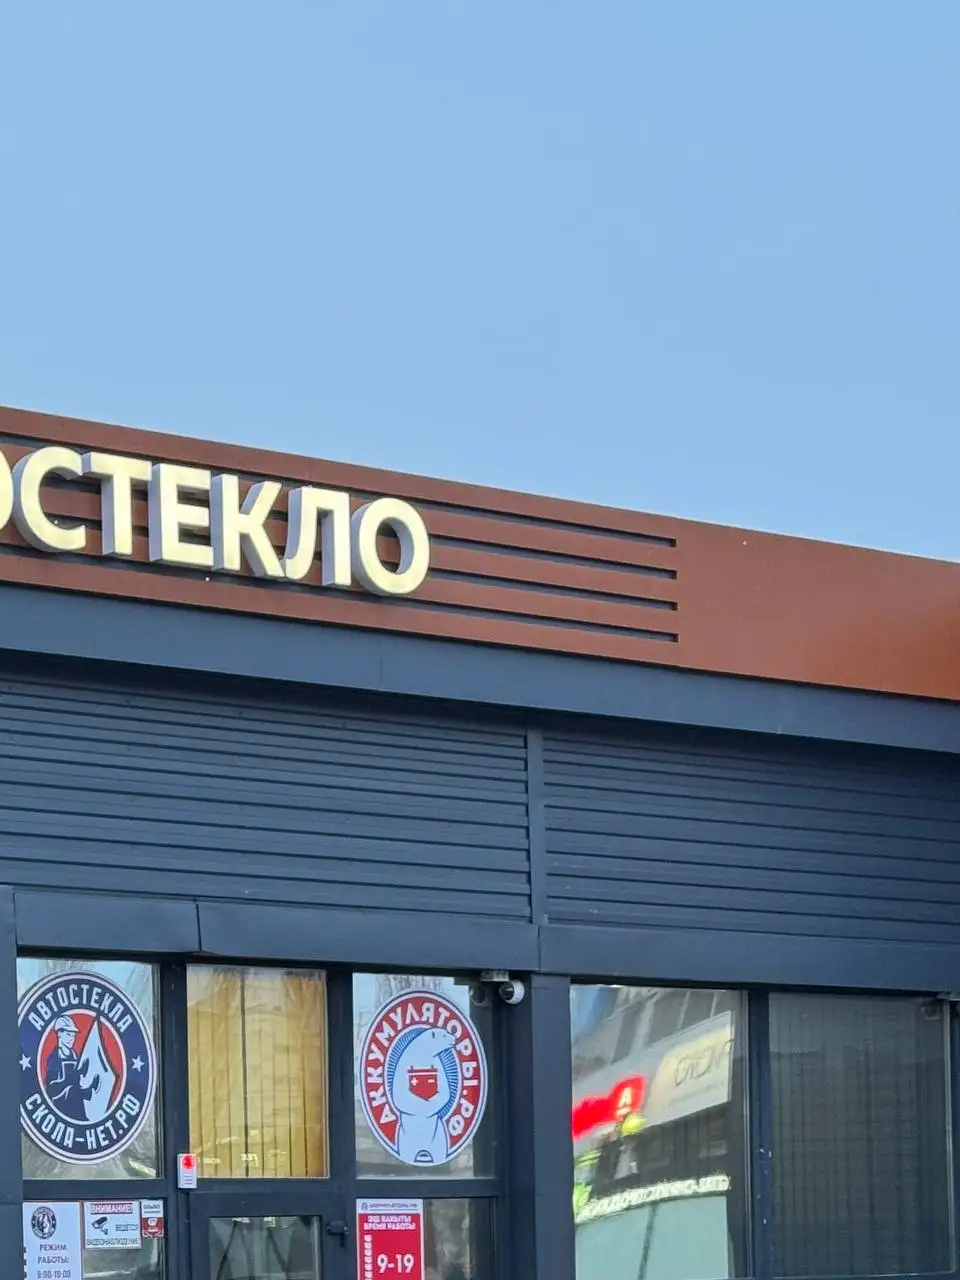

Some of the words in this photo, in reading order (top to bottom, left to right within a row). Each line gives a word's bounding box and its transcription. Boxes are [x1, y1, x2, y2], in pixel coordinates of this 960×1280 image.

[28, 984, 134, 1033] АВТОСТЕКЛА
[367, 1002, 479, 1137] АККУМУЛЯТОРЫ.РФ
[25, 1093, 140, 1150] СКОЛА-НЕТ.РФ
[377, 1253, 414, 1274] 9-19
